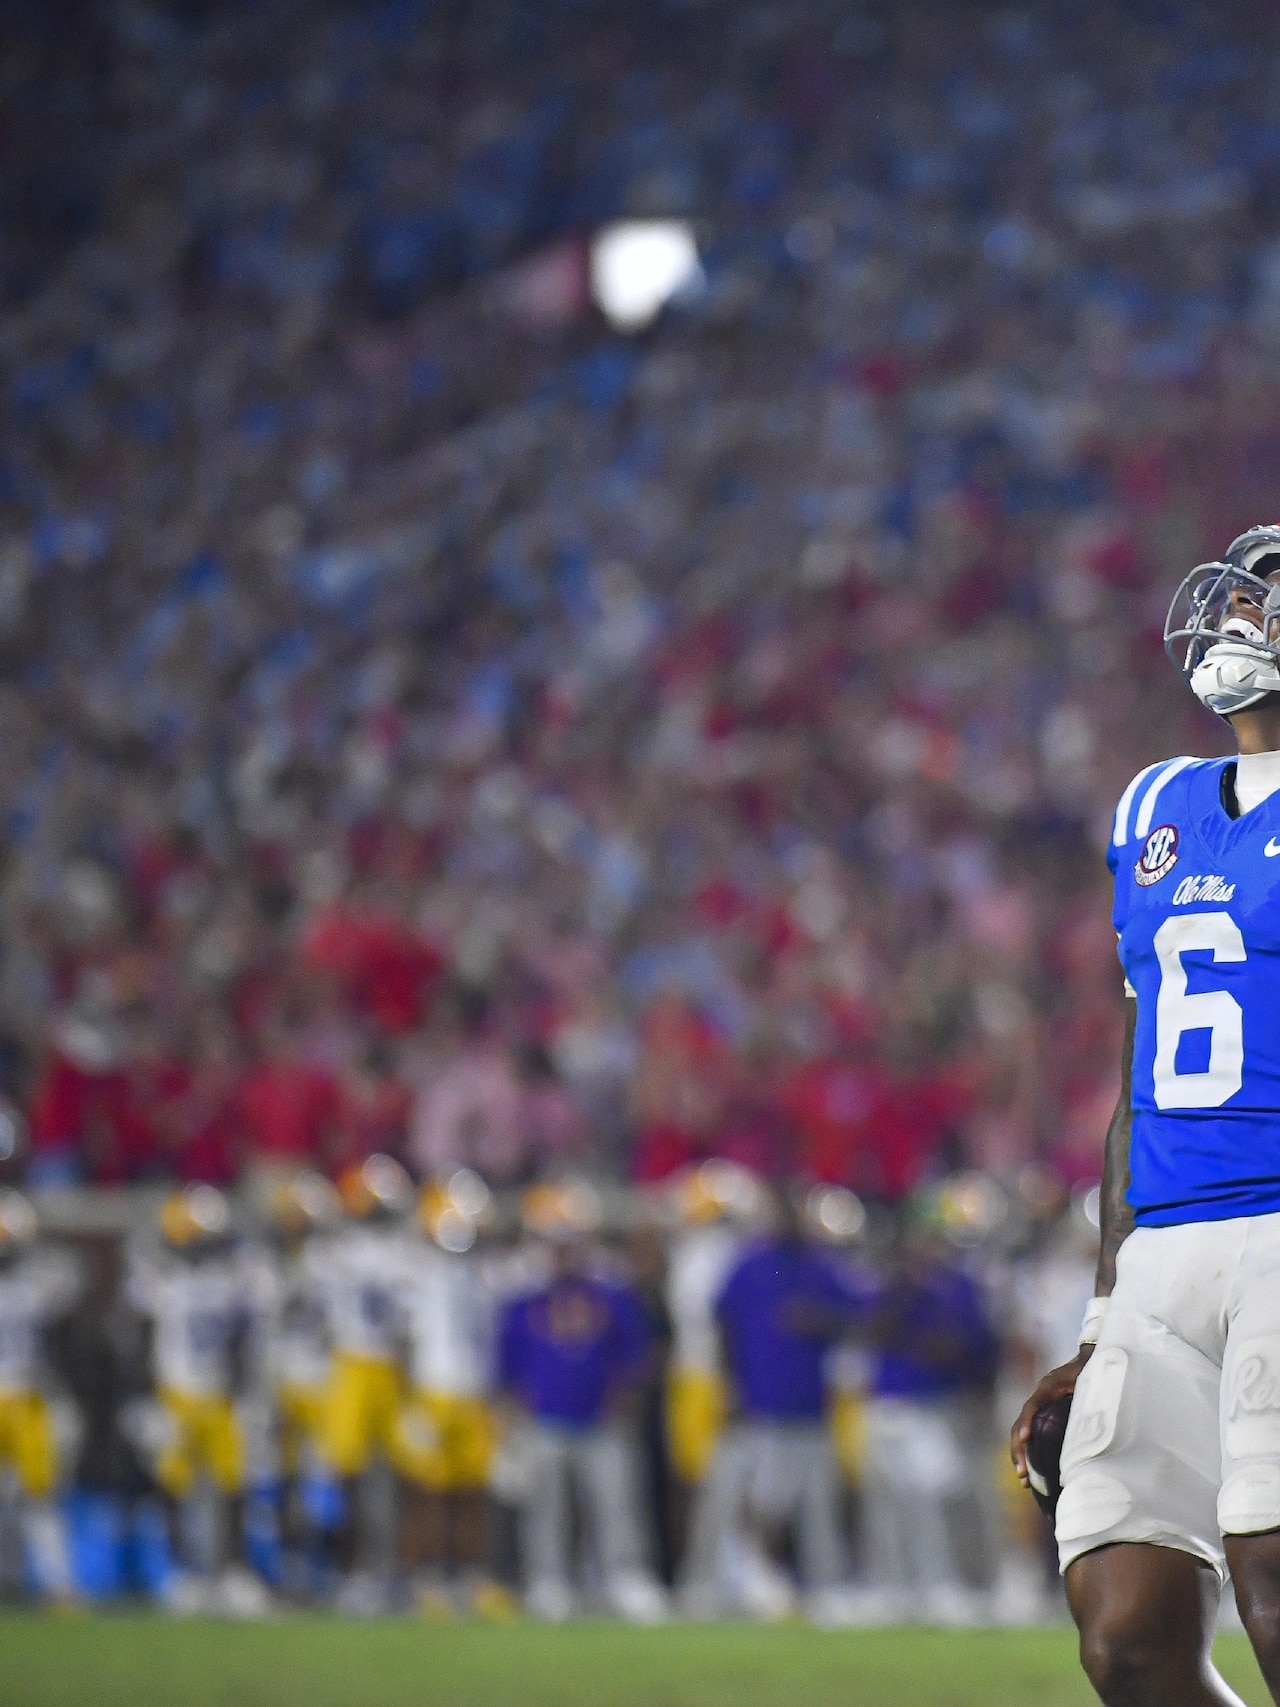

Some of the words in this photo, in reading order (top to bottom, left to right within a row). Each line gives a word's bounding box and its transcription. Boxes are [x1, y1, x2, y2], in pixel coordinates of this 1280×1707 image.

[1142, 826, 1176, 870] SEC
[1172, 875, 1202, 905] Ole
[1194, 875, 1237, 902] Miss
[1153, 911, 1247, 1110] 6
